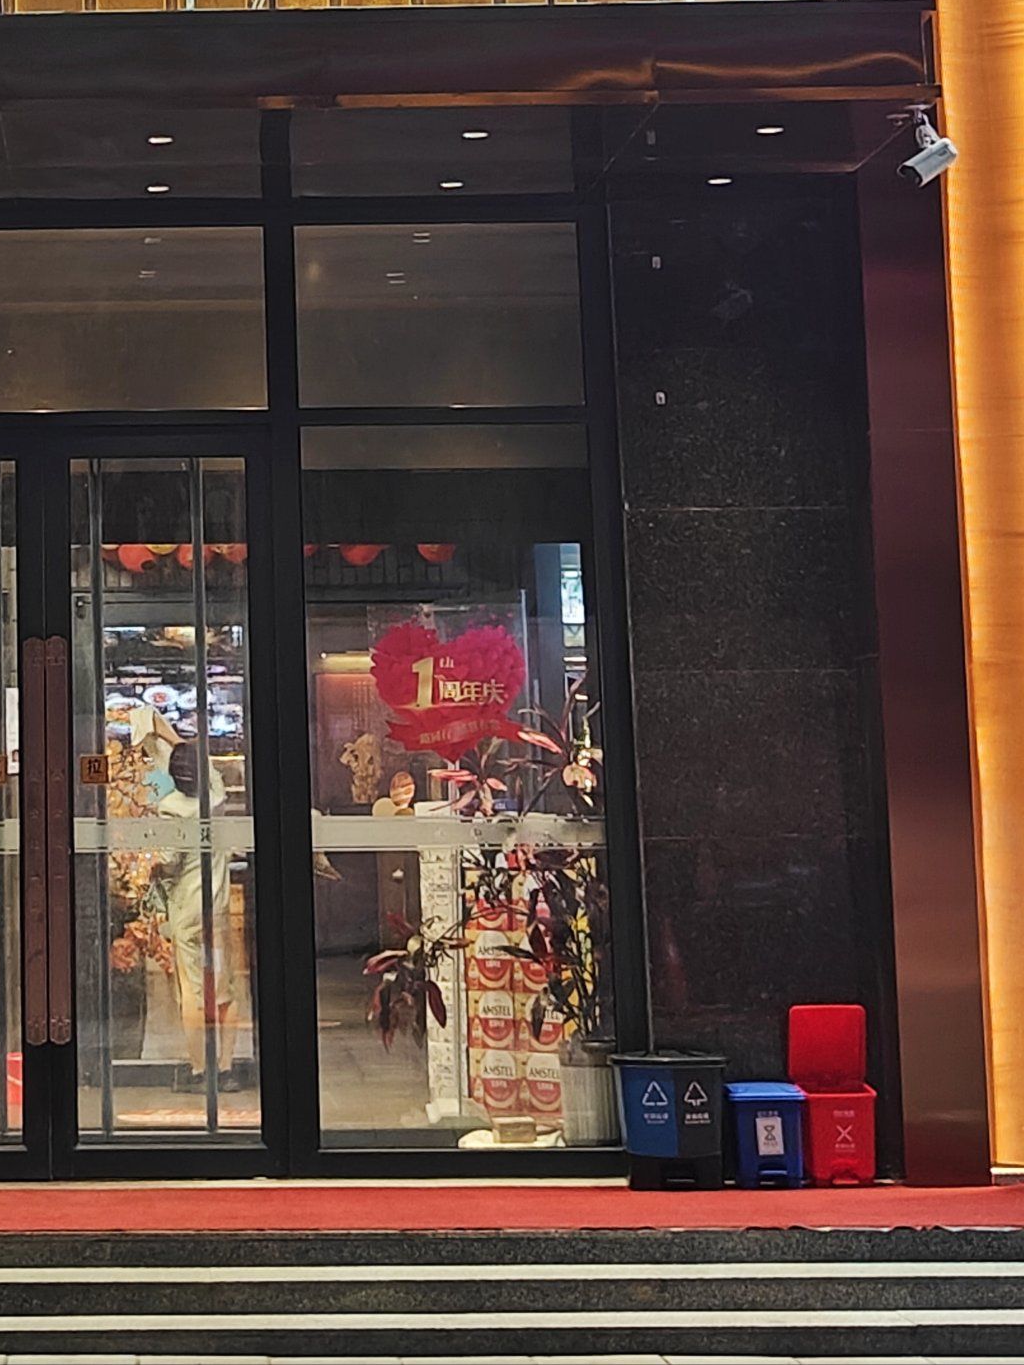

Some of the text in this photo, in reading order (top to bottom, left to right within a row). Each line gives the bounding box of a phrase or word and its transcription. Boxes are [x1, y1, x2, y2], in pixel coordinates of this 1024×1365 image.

[87, 759, 103, 775] 拉
[482, 1004, 512, 1017] AMSTEL
[483, 1065, 514, 1077] AMSTEL
[528, 1067, 561, 1080] AMSTEL
